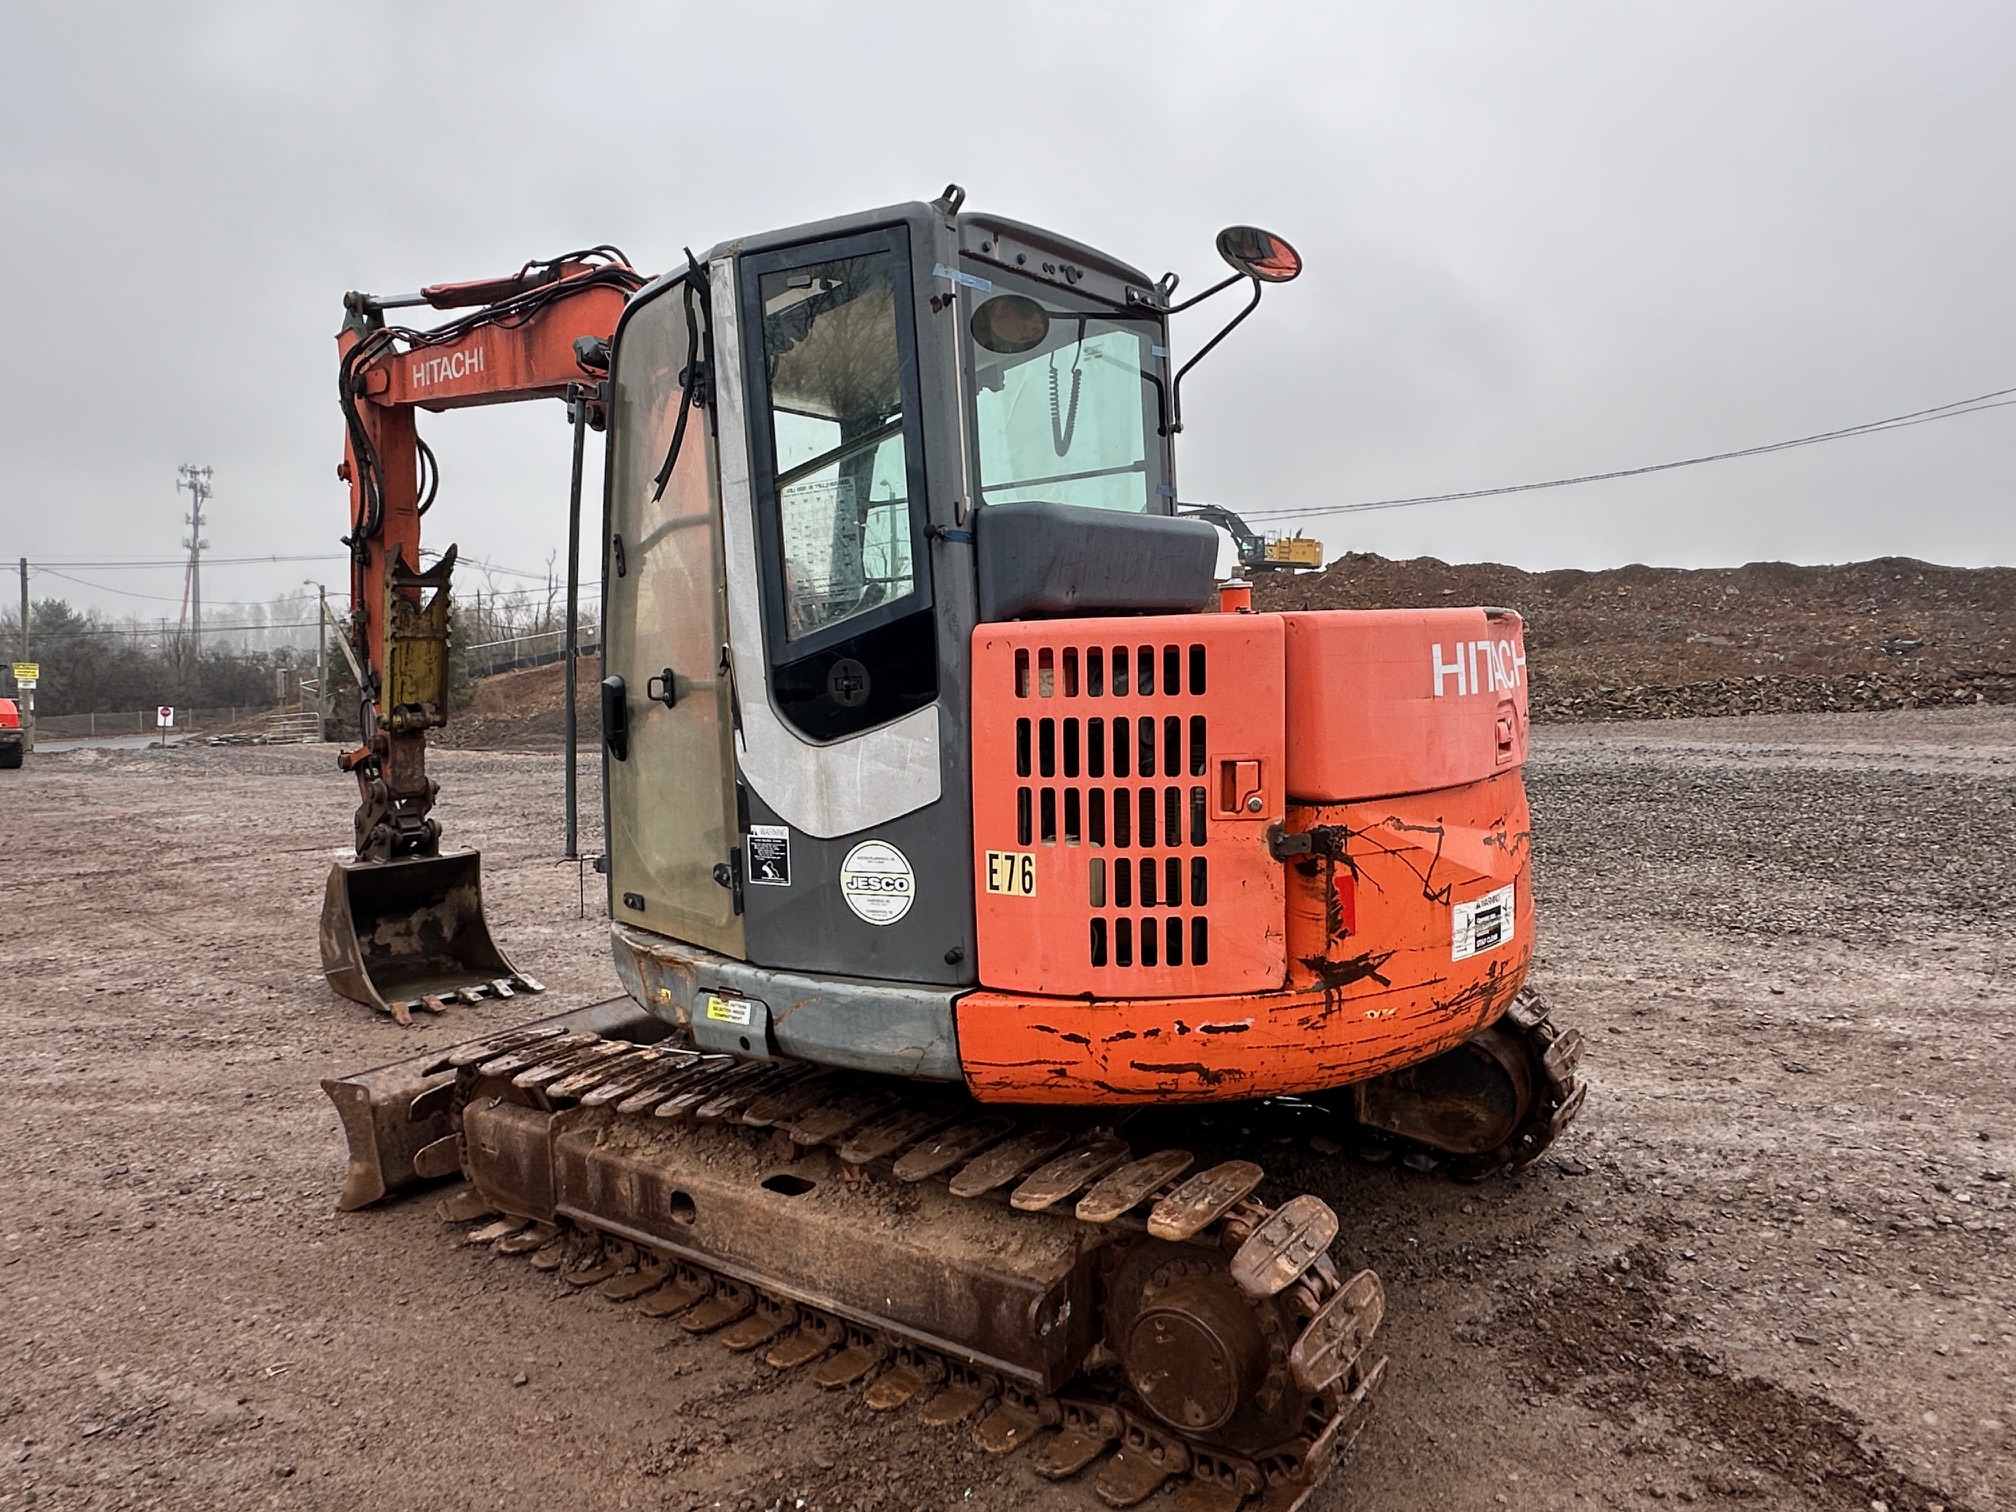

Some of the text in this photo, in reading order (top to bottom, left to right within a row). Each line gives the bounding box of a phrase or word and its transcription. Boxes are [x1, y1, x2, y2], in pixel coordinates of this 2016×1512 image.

[412, 346, 485, 389] HITACHI
[760, 828, 788, 838] WARNING
[846, 875, 910, 893] JESCO
[988, 853, 1034, 895] E76
